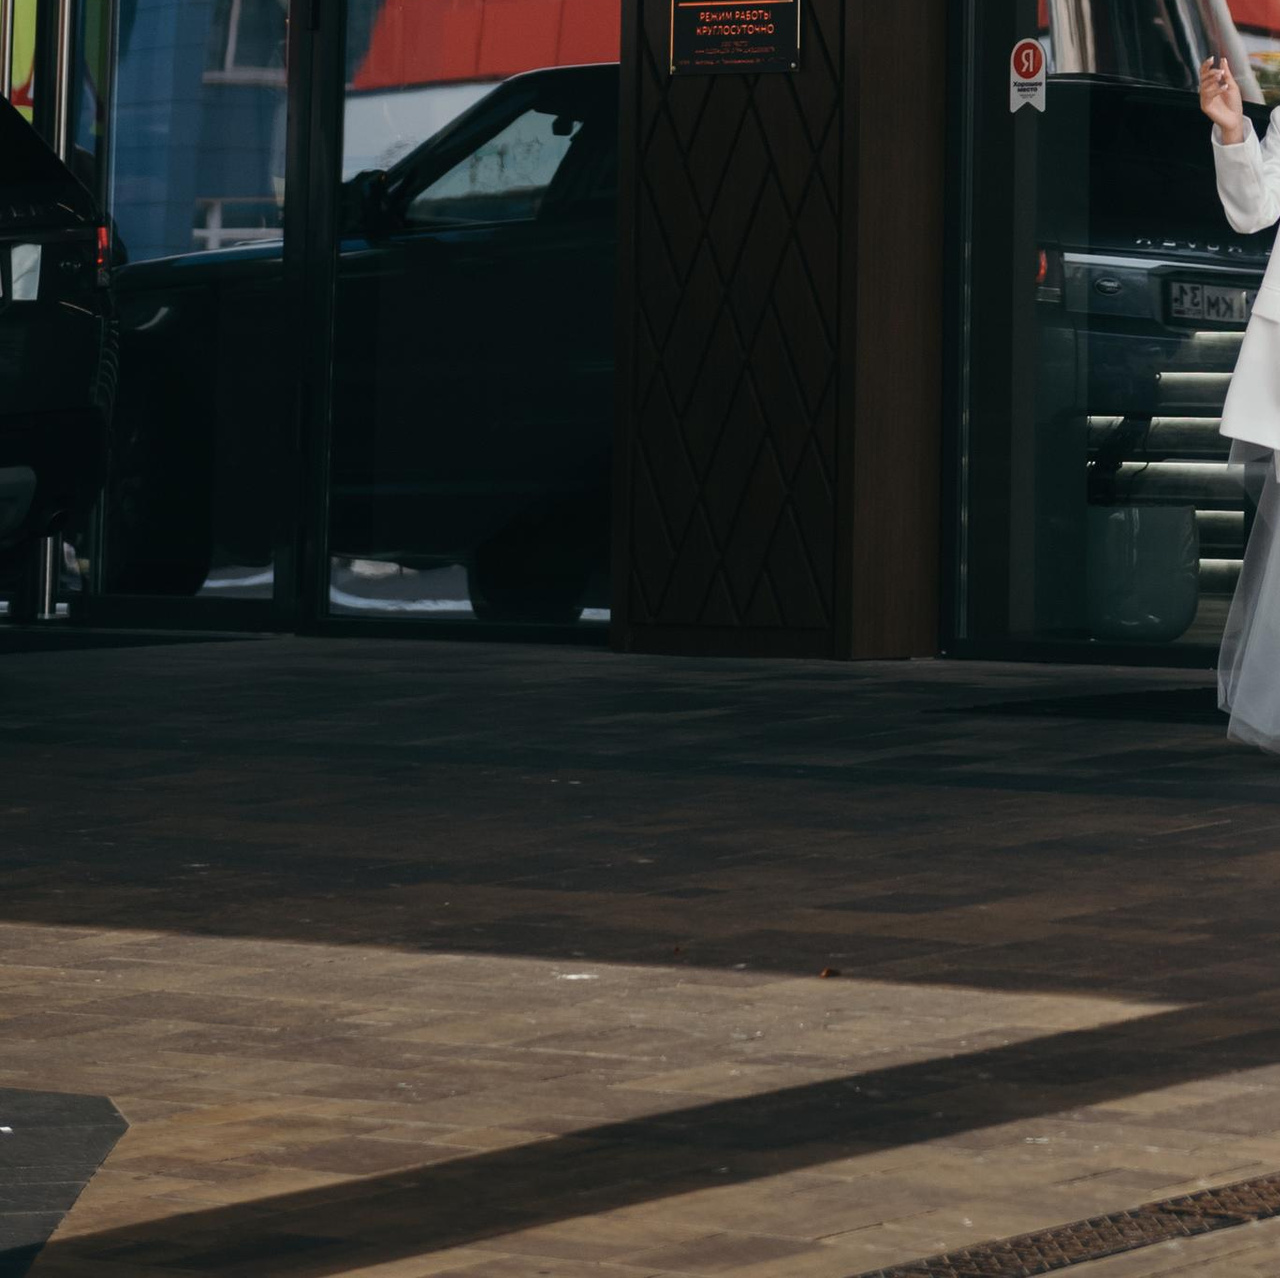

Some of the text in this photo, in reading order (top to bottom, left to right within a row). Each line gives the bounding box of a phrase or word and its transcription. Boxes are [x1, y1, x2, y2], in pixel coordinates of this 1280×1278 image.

[699, 9, 772, 22] РЕЖИМ РАБОТЫ
[695, 24, 775, 36] КРУГЛОСУТОЧНО
[1021, 49, 1034, 72] Я
